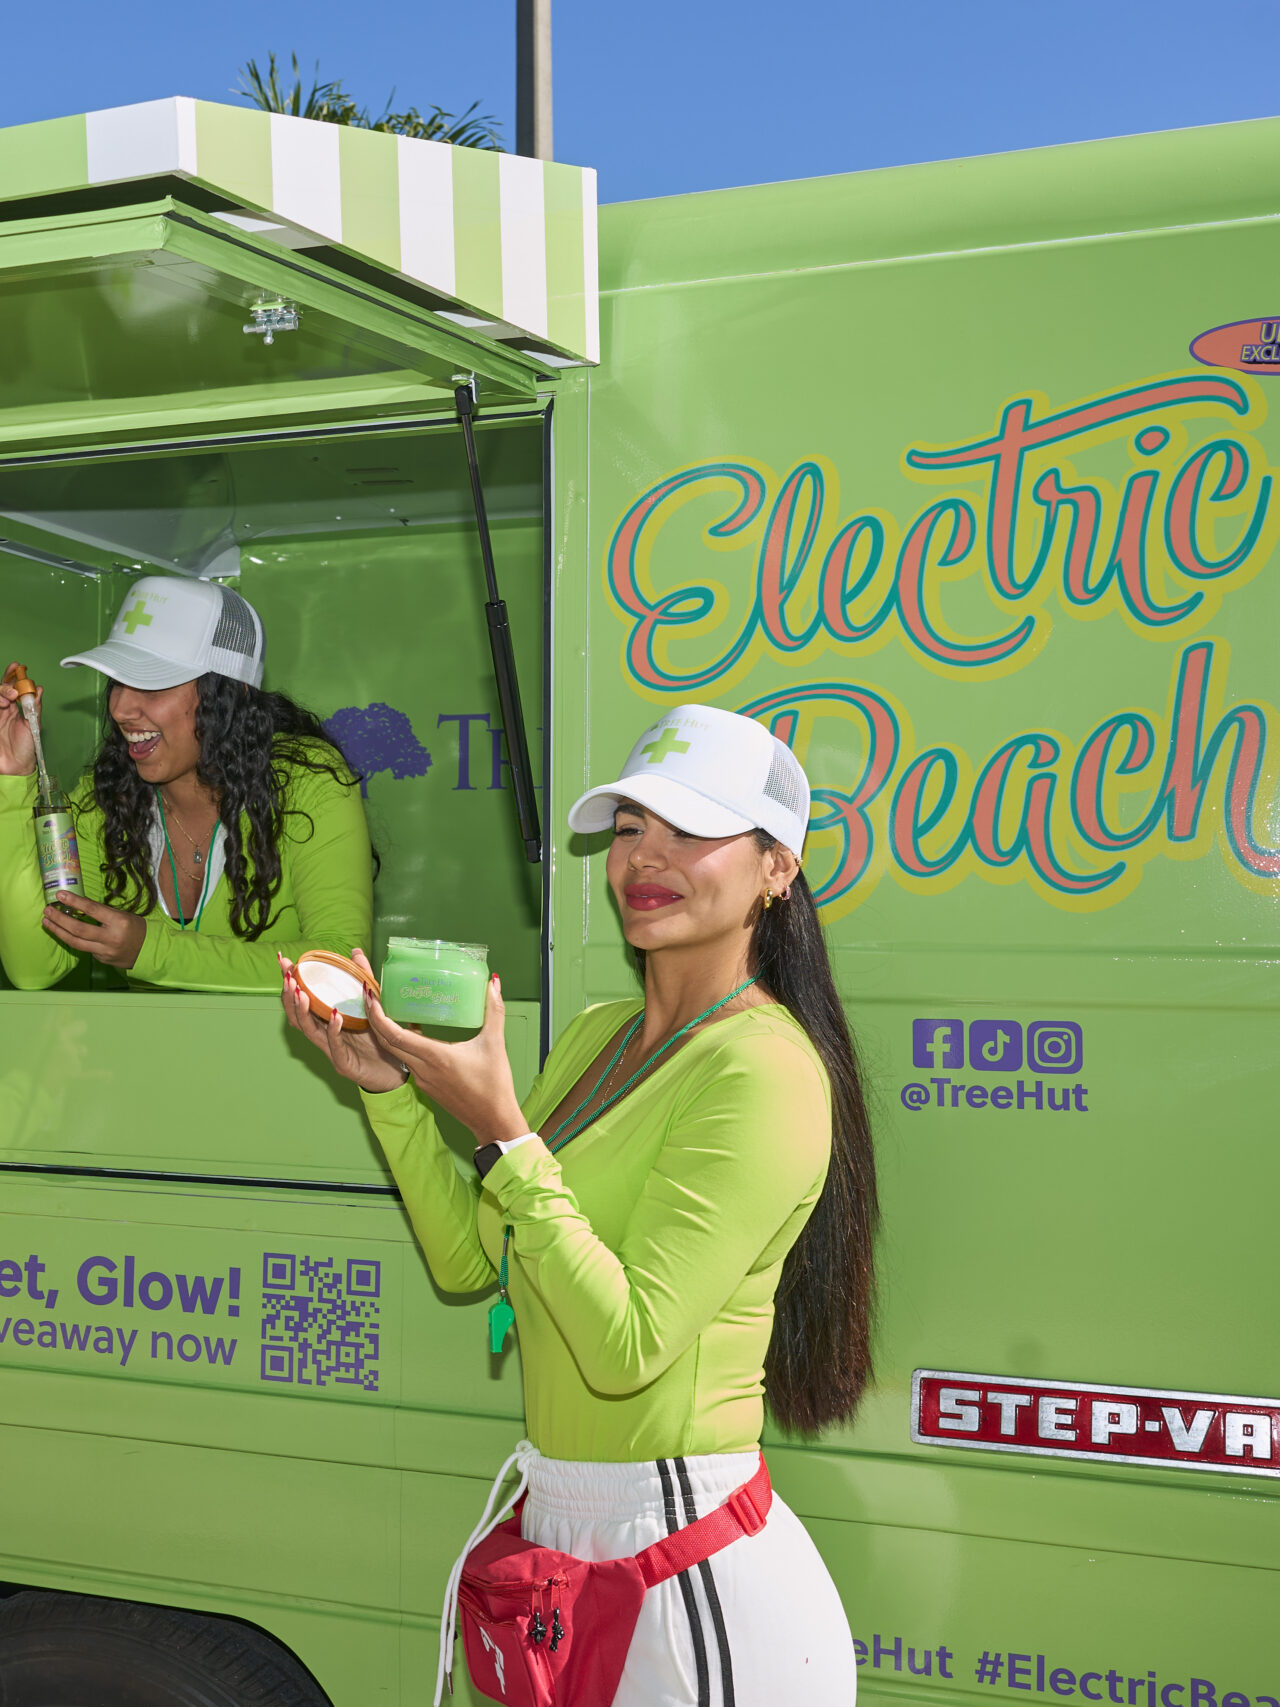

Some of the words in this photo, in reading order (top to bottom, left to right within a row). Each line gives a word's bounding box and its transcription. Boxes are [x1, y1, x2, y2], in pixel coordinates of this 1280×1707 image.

[1261, 323, 1280, 343] U
[607, 374, 1272, 692] Electric
[733, 641, 1280, 908] Beach
[900, 1077, 1089, 1112] @TreeHut
[76, 1255, 241, 1318] Glow!
[151, 1330, 238, 1366] now
[938, 1387, 1272, 1460] STEP-VA
[852, 1634, 953, 1679] eHut
